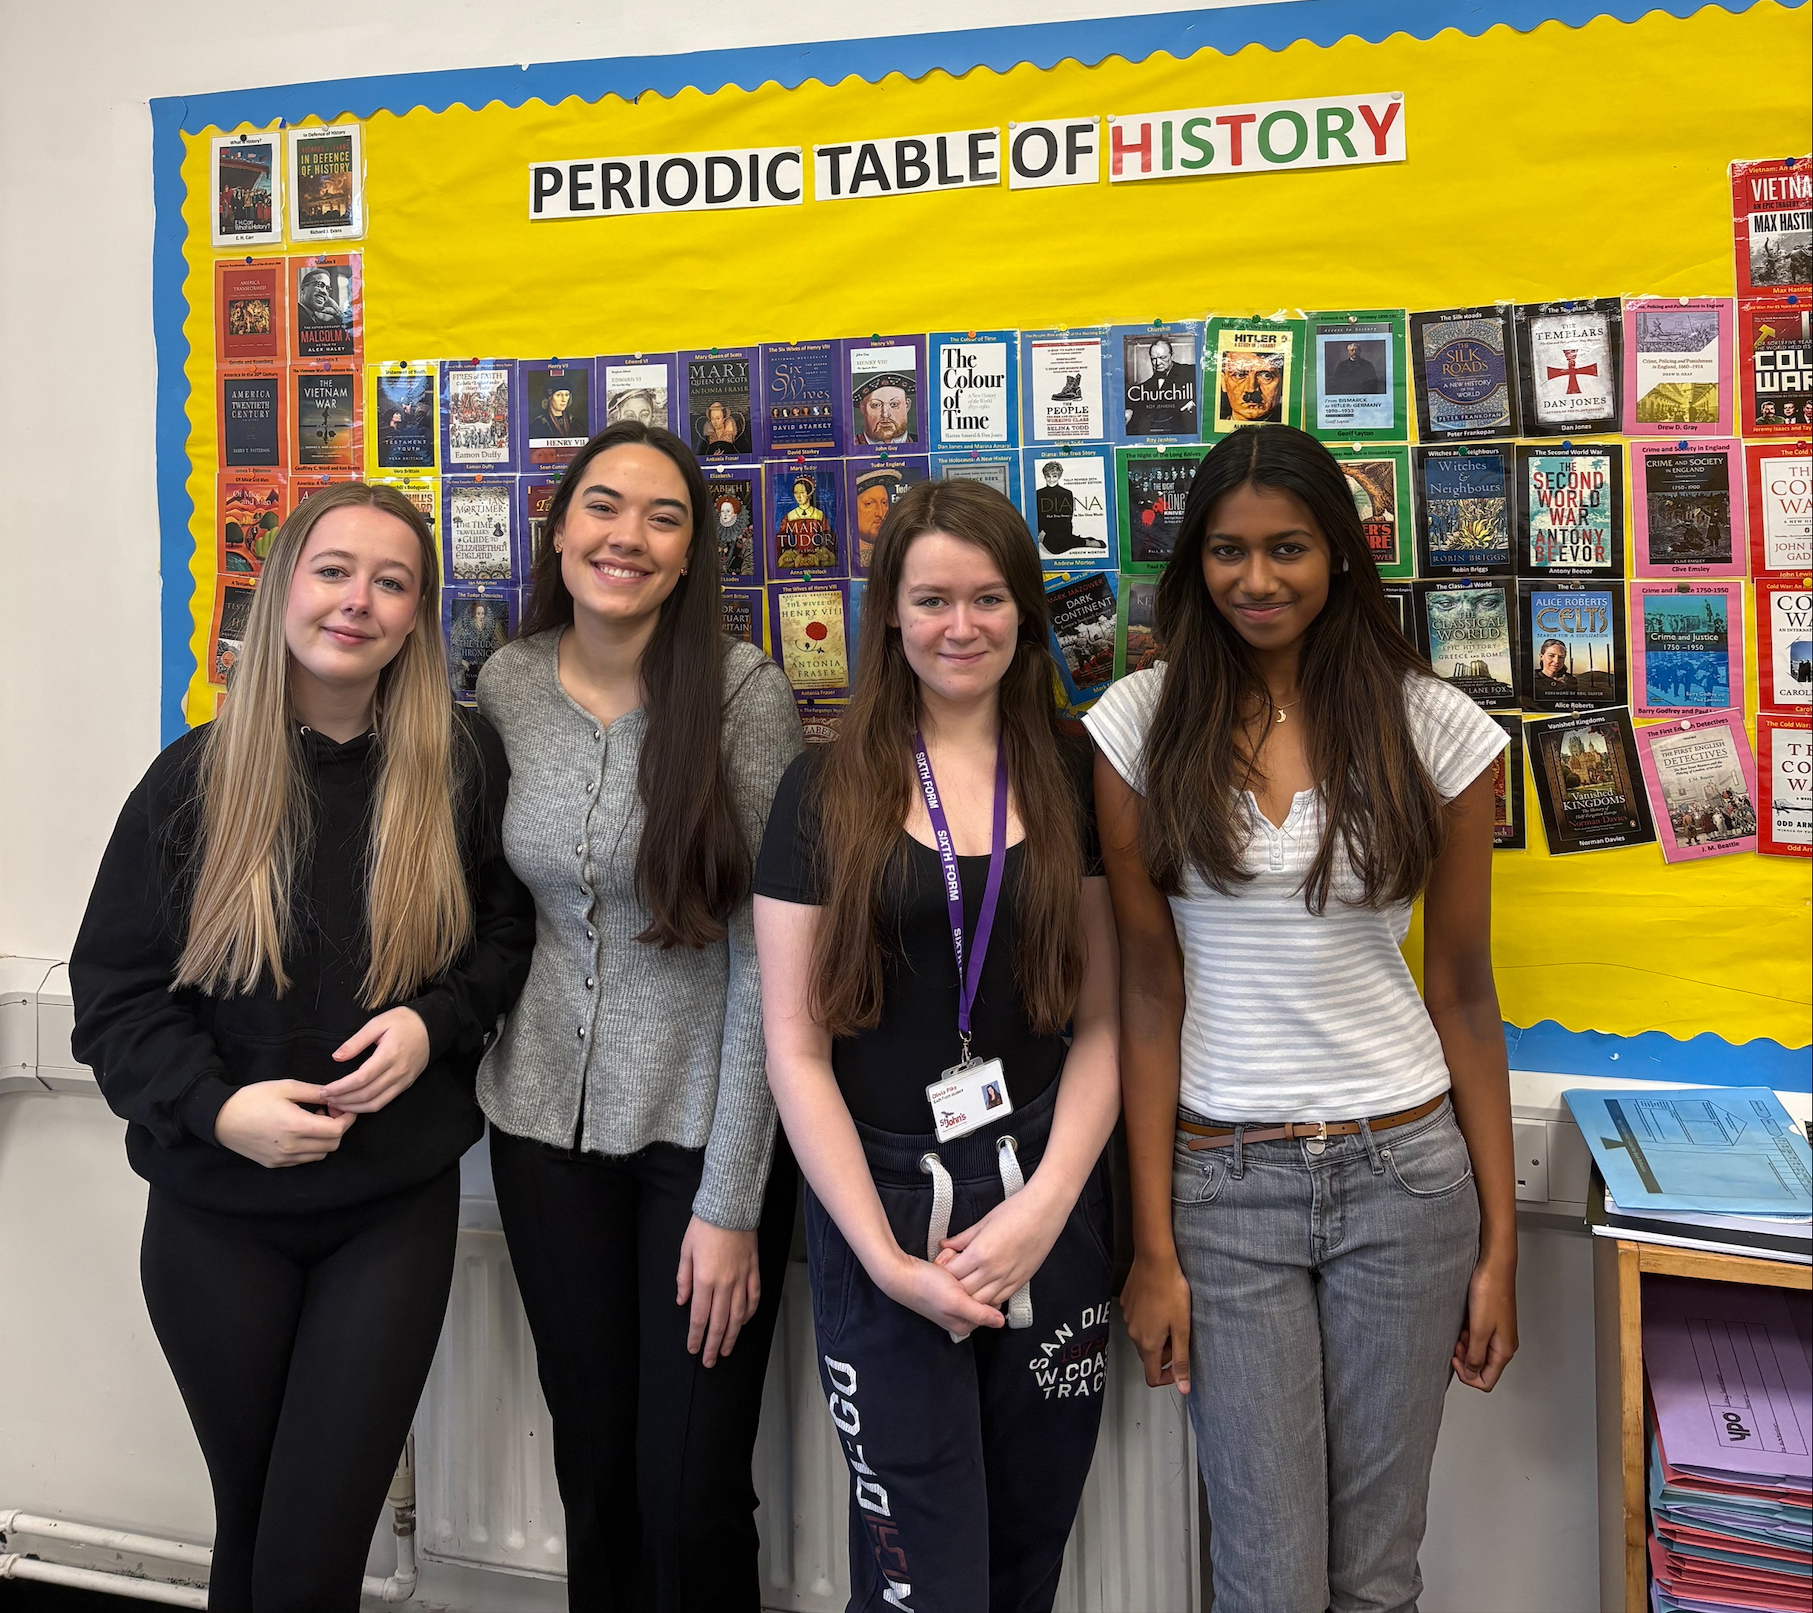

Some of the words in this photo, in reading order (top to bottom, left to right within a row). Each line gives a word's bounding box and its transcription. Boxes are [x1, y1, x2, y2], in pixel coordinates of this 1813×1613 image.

[301, 155, 308, 164] IN
[313, 152, 349, 163] DEFENCE
[532, 152, 800, 213] PERIODIC
[817, 133, 998, 195] TABLE
[1012, 124, 1094, 177] OF
[1112, 103, 1401, 176] HISTORY
[302, 165, 311, 176] OF
[314, 164, 349, 174] HISTORY
[1754, 213, 1777, 233] MAX
[1234, 334, 1276, 343] HITLER
[1535, 328, 1604, 341] TEMPLARS
[943, 348, 977, 369] The
[1446, 348, 1481, 362] SILK
[690, 363, 749, 380] MARY
[1442, 361, 1489, 377] ROADS
[943, 369, 1005, 389] Colour
[1464, 379, 1491, 387] HISTORY
[304, 388, 348, 398] VIETNAM
[943, 388, 963, 409] of
[1128, 383, 1193, 401] Churchill
[316, 400, 336, 408] WAR
[1543, 400, 1567, 408] DAN
[1570, 397, 1607, 408] JONES
[232, 410, 270, 418] CENTURY
[1047, 406, 1089, 415] PEOPLE
[799, 422, 831, 430] STARKEY
[943, 410, 989, 430] Time
[482, 451, 501, 459] Duffy
[1438, 460, 1487, 471] Witches
[1559, 462, 1576, 471] THE
[1646, 460, 1672, 468] CRIME
[1689, 458, 1724, 466] SOCIETY
[1458, 472, 1470, 482] &
[1533, 472, 1603, 490] SECOND
[233, 490, 242, 499] Of
[1430, 483, 1500, 497] Neighbours
[257, 498, 272, 506] Men
[1040, 496, 1103, 513] DIANA
[1537, 490, 1601, 508] WORLD
[456, 505, 504, 513] MORTIMER
[1550, 508, 1589, 526] WAR
[786, 522, 823, 533] MARY
[777, 534, 835, 547] TUDOR
[1535, 529, 1603, 545] ANTONY
[1433, 555, 1465, 563] ROBIN
[1469, 553, 1506, 561] BRIGGS
[1535, 546, 1605, 562] BEEVOR
[1068, 579, 1103, 596] MAZOWER
[1066, 593, 1093, 610] DARK
[1536, 598, 1561, 606] ALICE
[1565, 598, 1607, 606] ROBERTS
[782, 609, 817, 617] HENRY
[821, 608, 842, 616] VIII
[1054, 597, 1112, 625] CONTINENT
[1432, 617, 1504, 630] CLASSICAL
[1437, 628, 1500, 642] WORLD
[1651, 633, 1676, 641] Crime
[1692, 634, 1718, 642] Justice
[791, 660, 840, 668] ANTONIA
[798, 670, 836, 678] FRASER
[1672, 748, 1693, 756] FIRST
[1695, 741, 1726, 752] ENGLISH
[1664, 748, 1728, 767] DETECTIVES
[916, 751, 930, 780] SIXTH
[924, 781, 939, 810] FORM
[1571, 788, 1614, 801] Vanished
[1563, 795, 1626, 812] KINGDOMS
[1568, 817, 1600, 828] Norman
[1601, 815, 1628, 824] Davies
[1579, 838, 1604, 846] Norman
[1605, 836, 1625, 844] Davies
[937, 830, 953, 863] SIXTH
[945, 864, 959, 902] FORM
[1029, 1323, 1074, 1370] SAN
[1722, 1412, 1751, 1442] ypo
